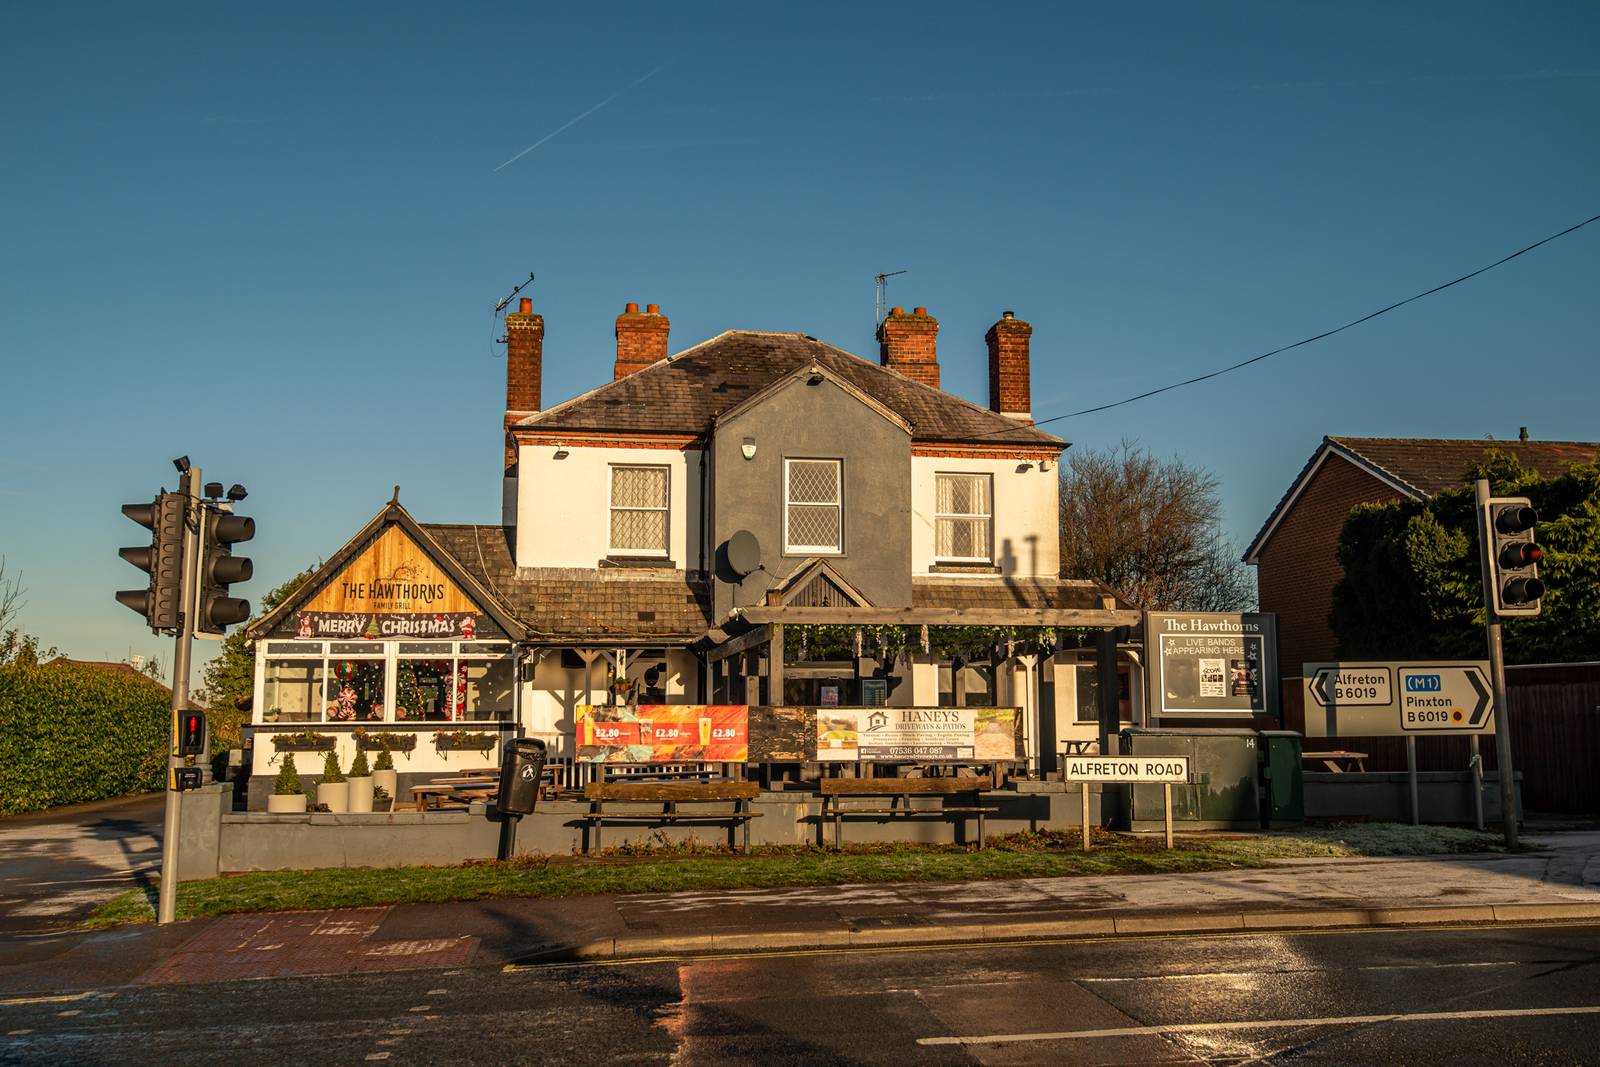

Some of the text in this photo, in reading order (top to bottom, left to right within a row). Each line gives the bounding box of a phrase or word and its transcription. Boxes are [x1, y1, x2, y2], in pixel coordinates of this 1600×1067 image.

[343, 579, 444, 603] THE HAWTHORNS
[373, 601, 411, 610] FAMILY GRILL
[318, 618, 456, 634] MERRY CHRISTMAS
[1163, 619, 1259, 632] The Hawthorns
[1186, 638, 1236, 646] LIVE BANDS
[1172, 646, 1245, 655] APPEARING HERE
[1334, 672, 1385, 685] Alfreton
[1406, 696, 1452, 707] Pinxton
[902, 711, 959, 722] HANEYS
[596, 728, 620, 737] £2.80
[655, 728, 679, 737] £2.80
[712, 728, 736, 737] £2.80
[1246, 738, 1256, 749] 14
[1070, 763, 1183, 776] ALFRETON ROAD
